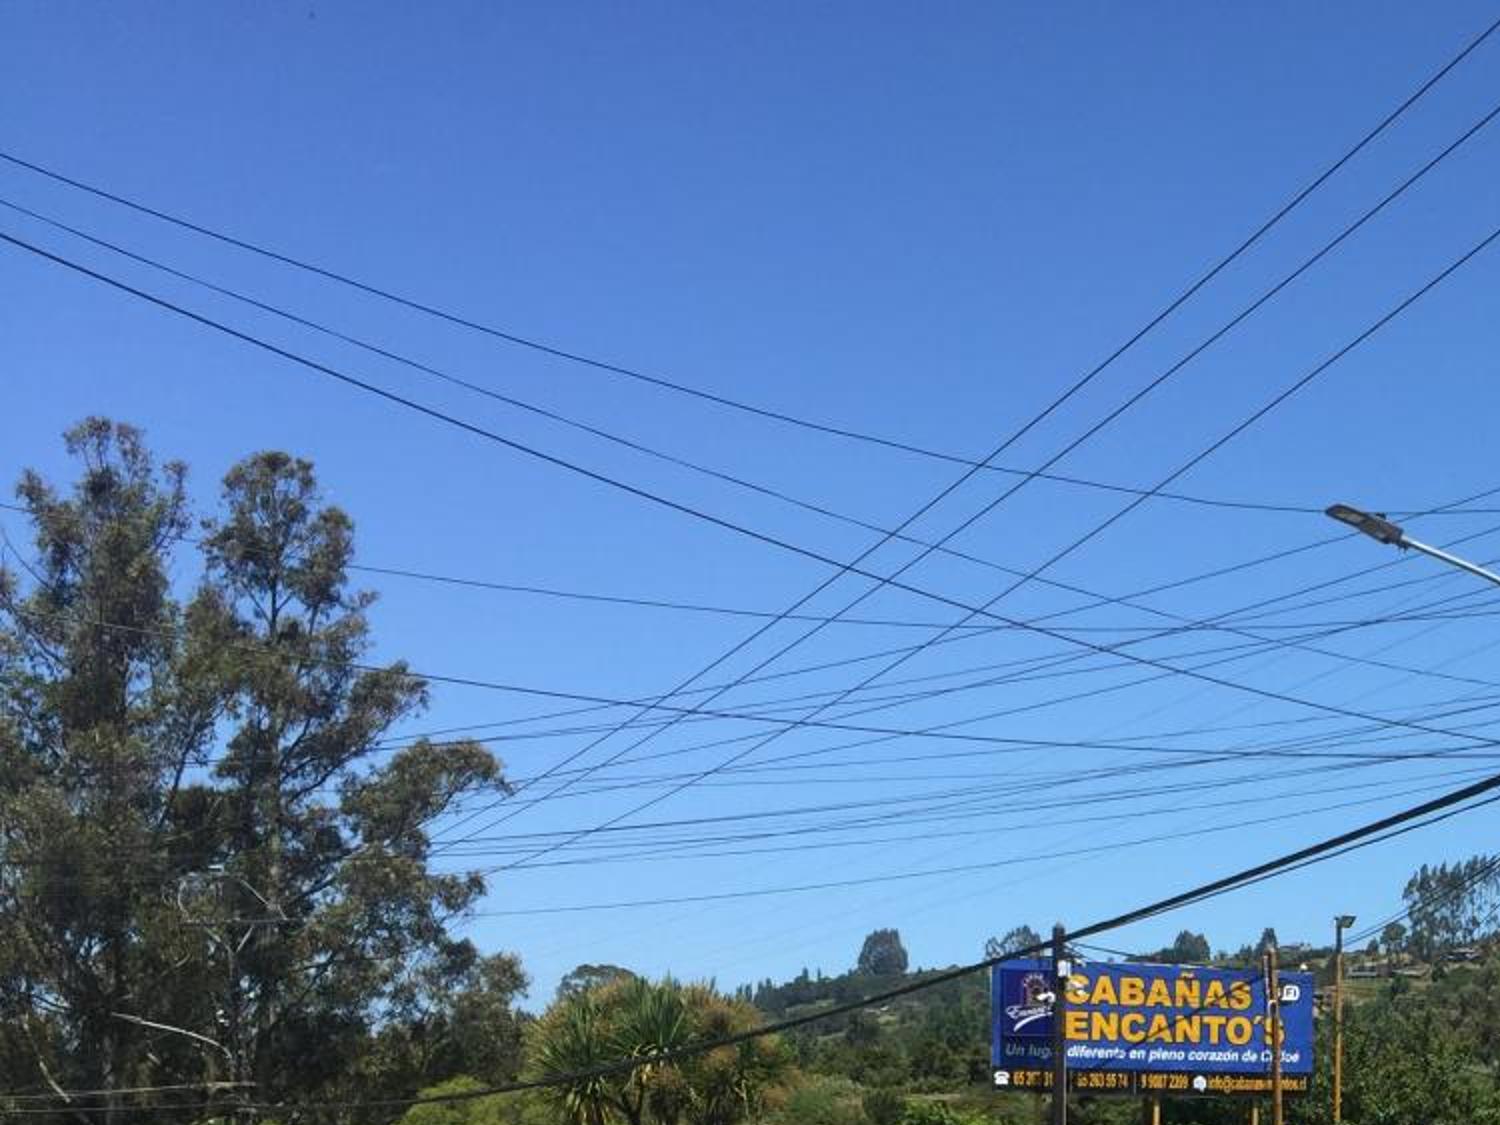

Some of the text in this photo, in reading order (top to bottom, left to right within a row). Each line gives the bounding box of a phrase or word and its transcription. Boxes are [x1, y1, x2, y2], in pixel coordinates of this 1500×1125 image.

[1064, 971, 1252, 1010] CABAÑAS
[1129, 1050, 1145, 1060] en
[1148, 1048, 1185, 1063] pleno
[1188, 1049, 1239, 1062] corazón
[1241, 1051, 1258, 1063] de
